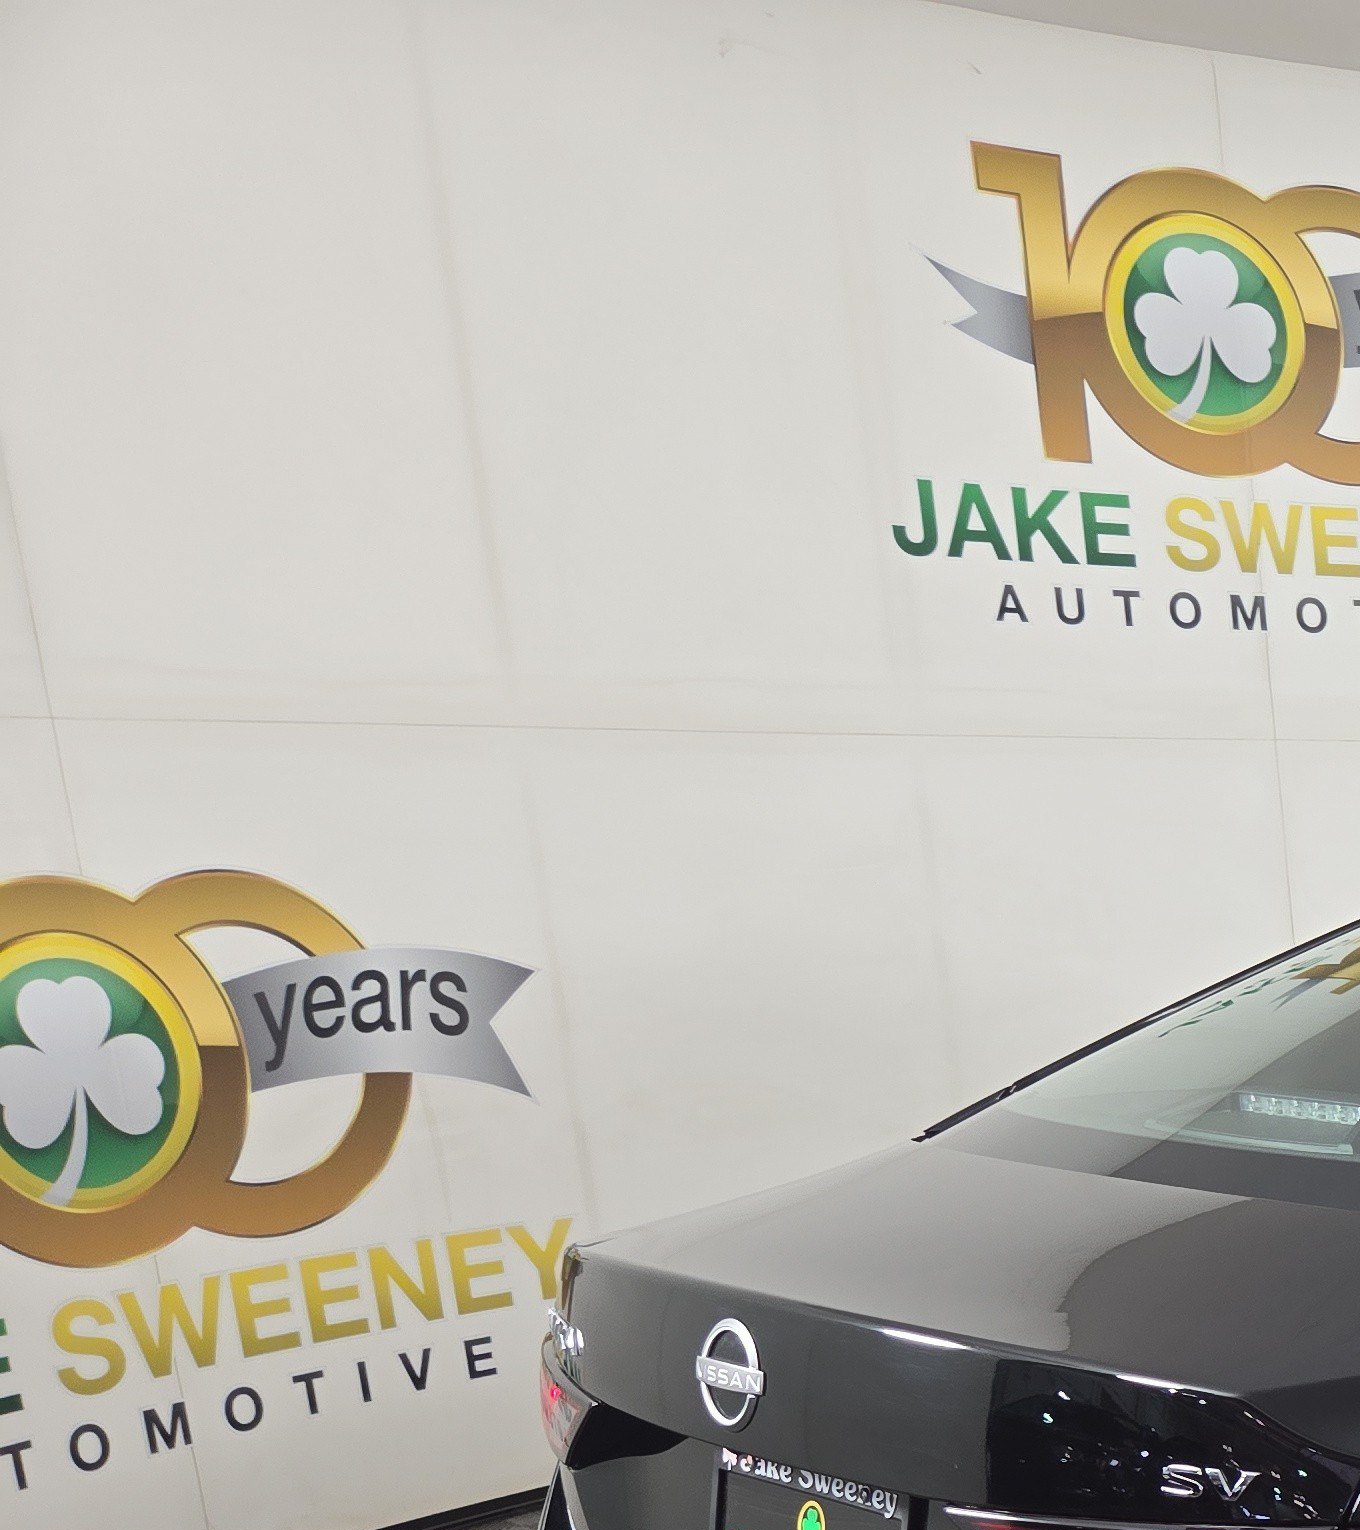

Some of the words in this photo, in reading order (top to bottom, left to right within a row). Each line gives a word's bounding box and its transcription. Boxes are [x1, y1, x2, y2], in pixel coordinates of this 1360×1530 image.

[891, 476, 1137, 568] JAKE
[253, 968, 470, 1072] years
[51, 1218, 573, 1396] SWEENEY
[1160, 1464, 1262, 1502] SV
